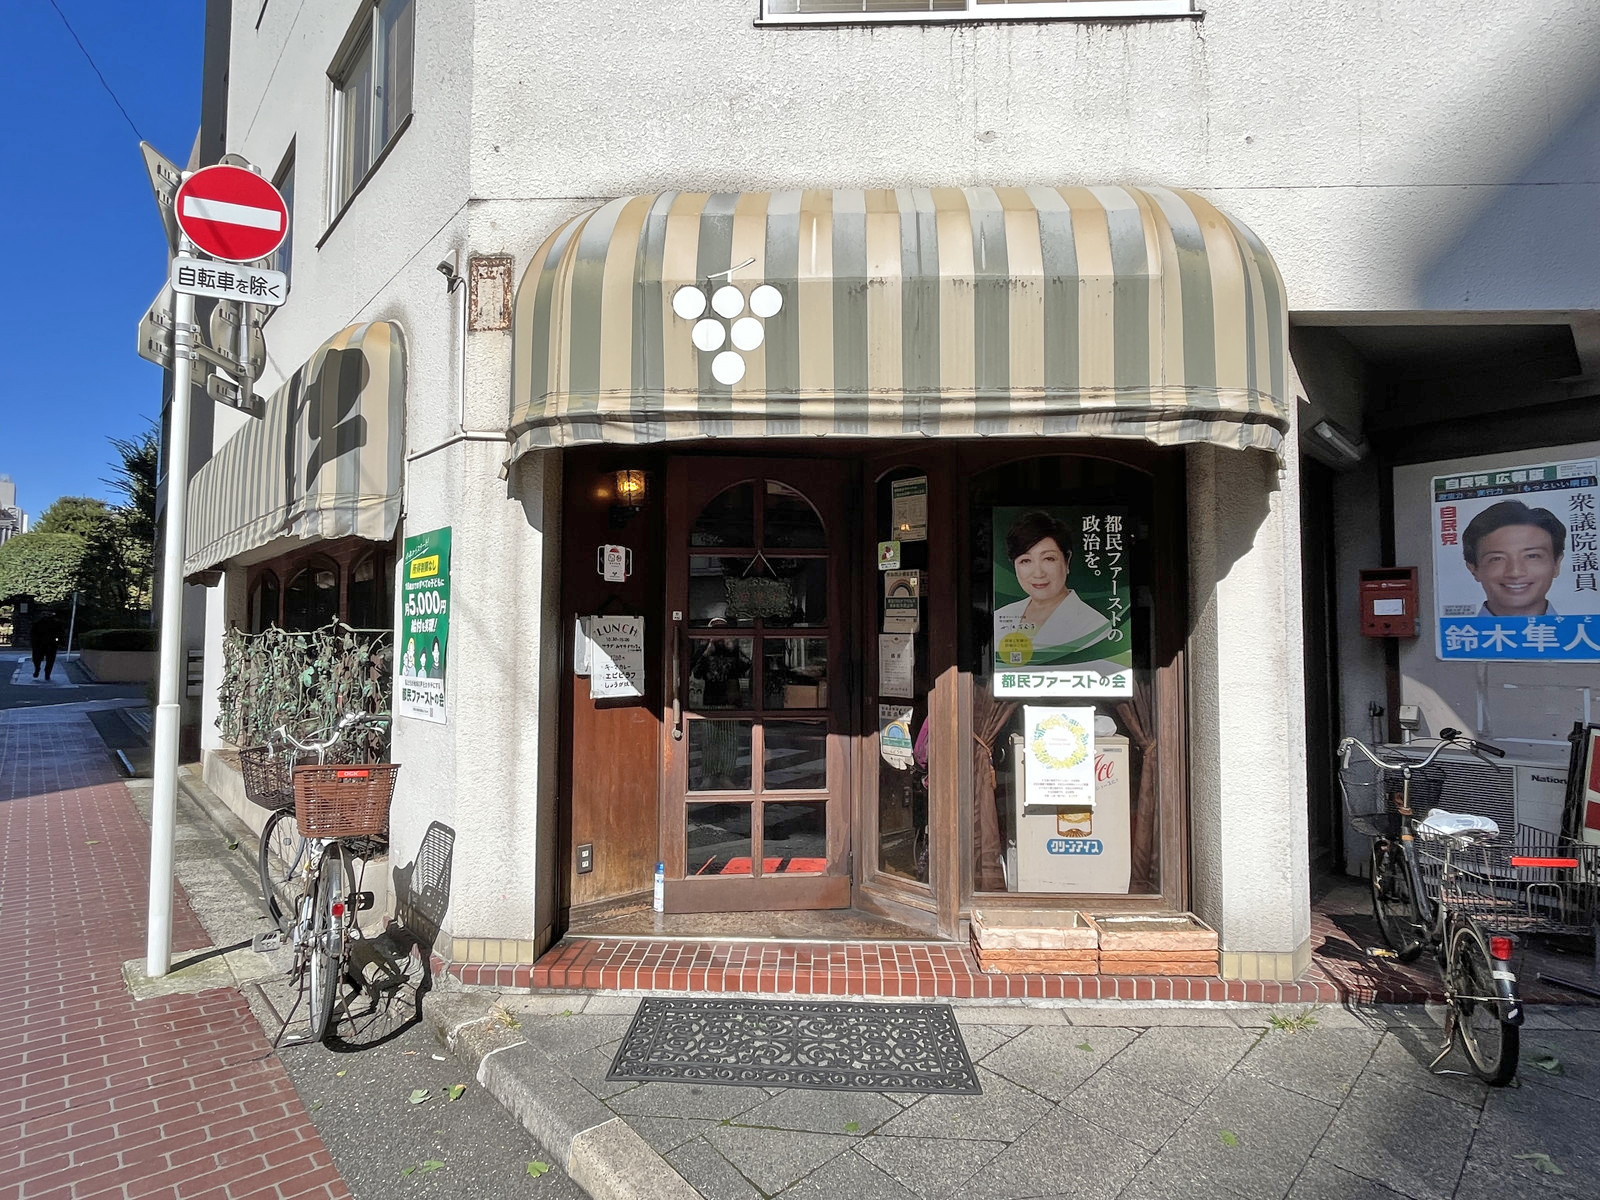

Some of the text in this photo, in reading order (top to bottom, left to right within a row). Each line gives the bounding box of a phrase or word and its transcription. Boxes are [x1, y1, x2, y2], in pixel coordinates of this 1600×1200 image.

[179, 266, 280, 298] 自転車を除く
[1440, 506, 1458, 545] 自民党
[1082, 515, 1101, 577] 政治を。
[1569, 493, 1599, 592] 衆議院議員
[1105, 515, 1123, 642] 都民ファーストの
[596, 623, 638, 637] LUNCH
[1445, 623, 1600, 653] 鈴木隼人
[1001, 673, 1127, 689] 都民ファーストの会
[1531, 775, 1568, 784] Nation
